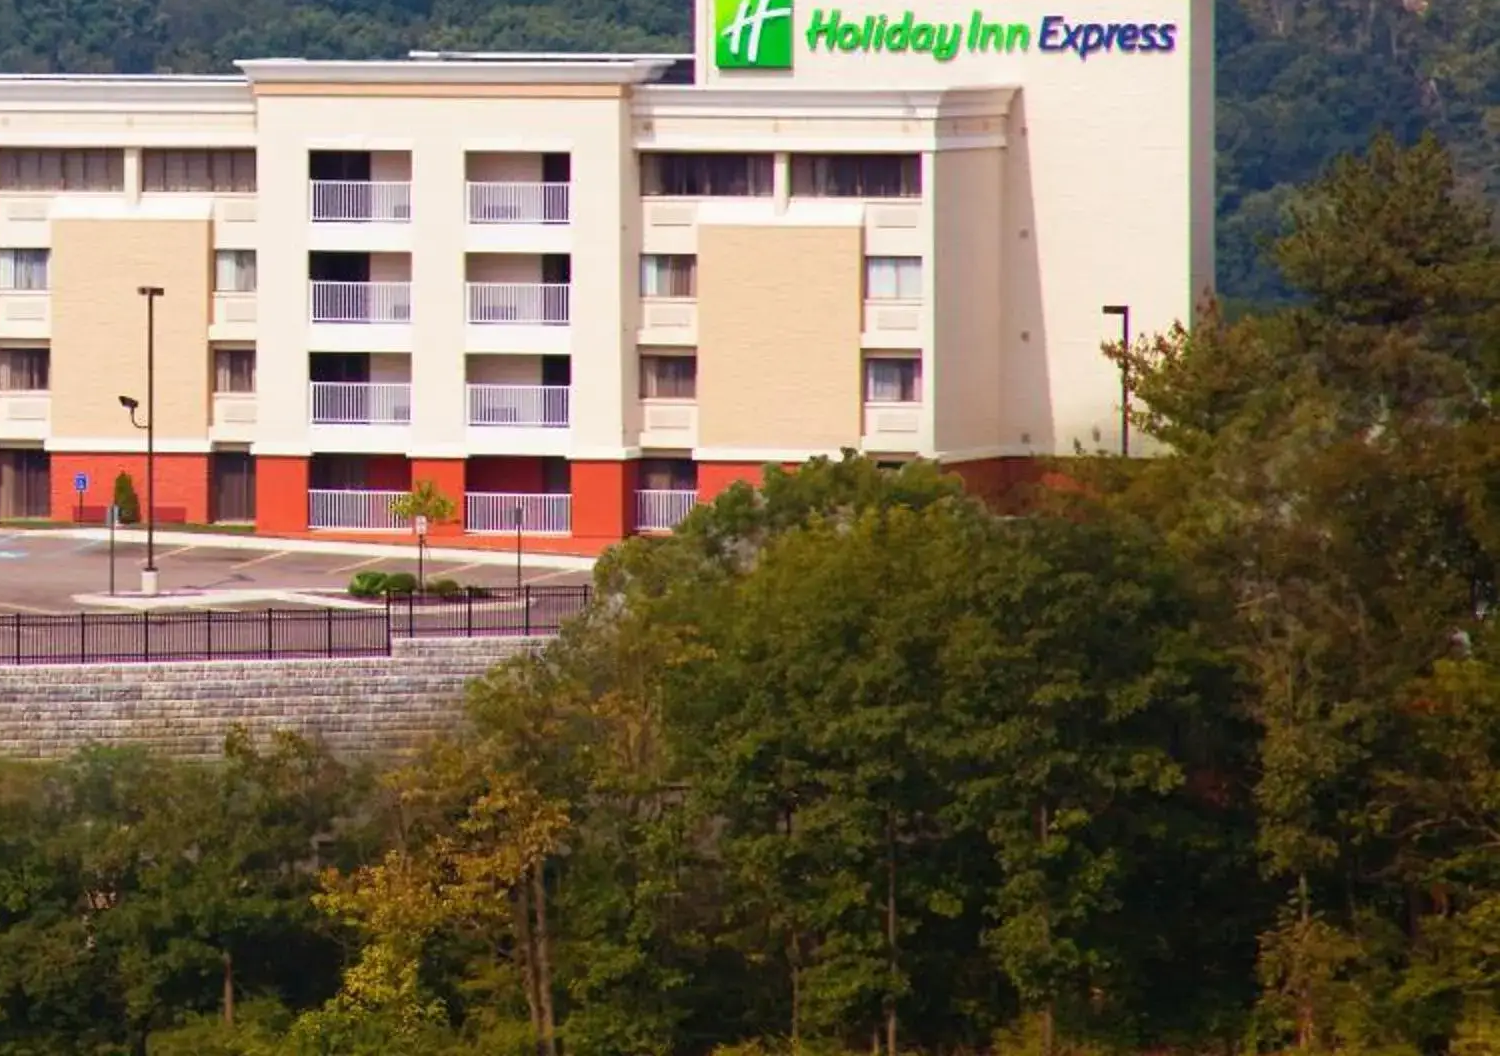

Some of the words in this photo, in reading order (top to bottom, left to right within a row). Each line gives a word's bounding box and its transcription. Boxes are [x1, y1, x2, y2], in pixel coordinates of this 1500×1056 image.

[805, 9, 962, 61] Holiday
[967, 9, 1030, 51] Inn
[1038, 15, 1176, 61] Express
